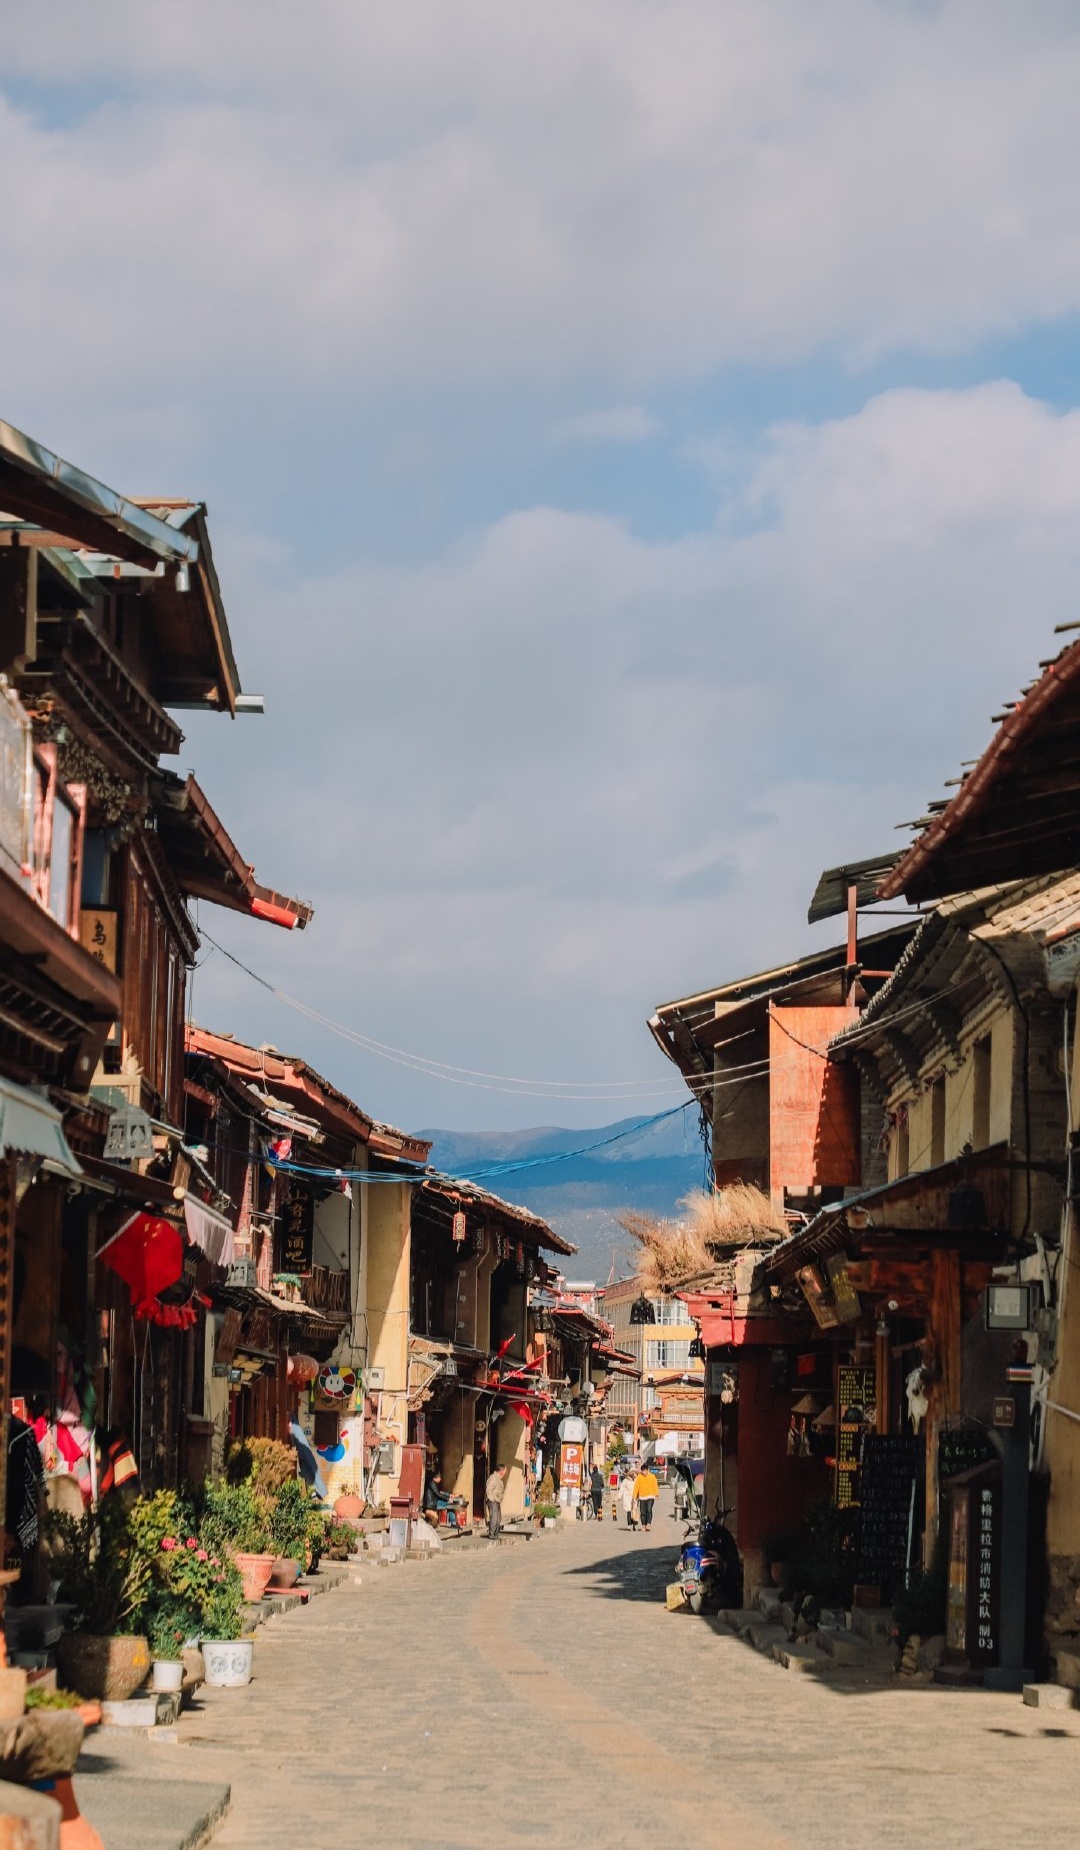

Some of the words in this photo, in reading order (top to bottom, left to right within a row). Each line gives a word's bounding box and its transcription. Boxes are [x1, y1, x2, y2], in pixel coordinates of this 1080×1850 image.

[566, 1448, 578, 1460] P
[979, 1489, 993, 1619] 香格里拉市消防大队
[978, 1637, 993, 1649] 03
